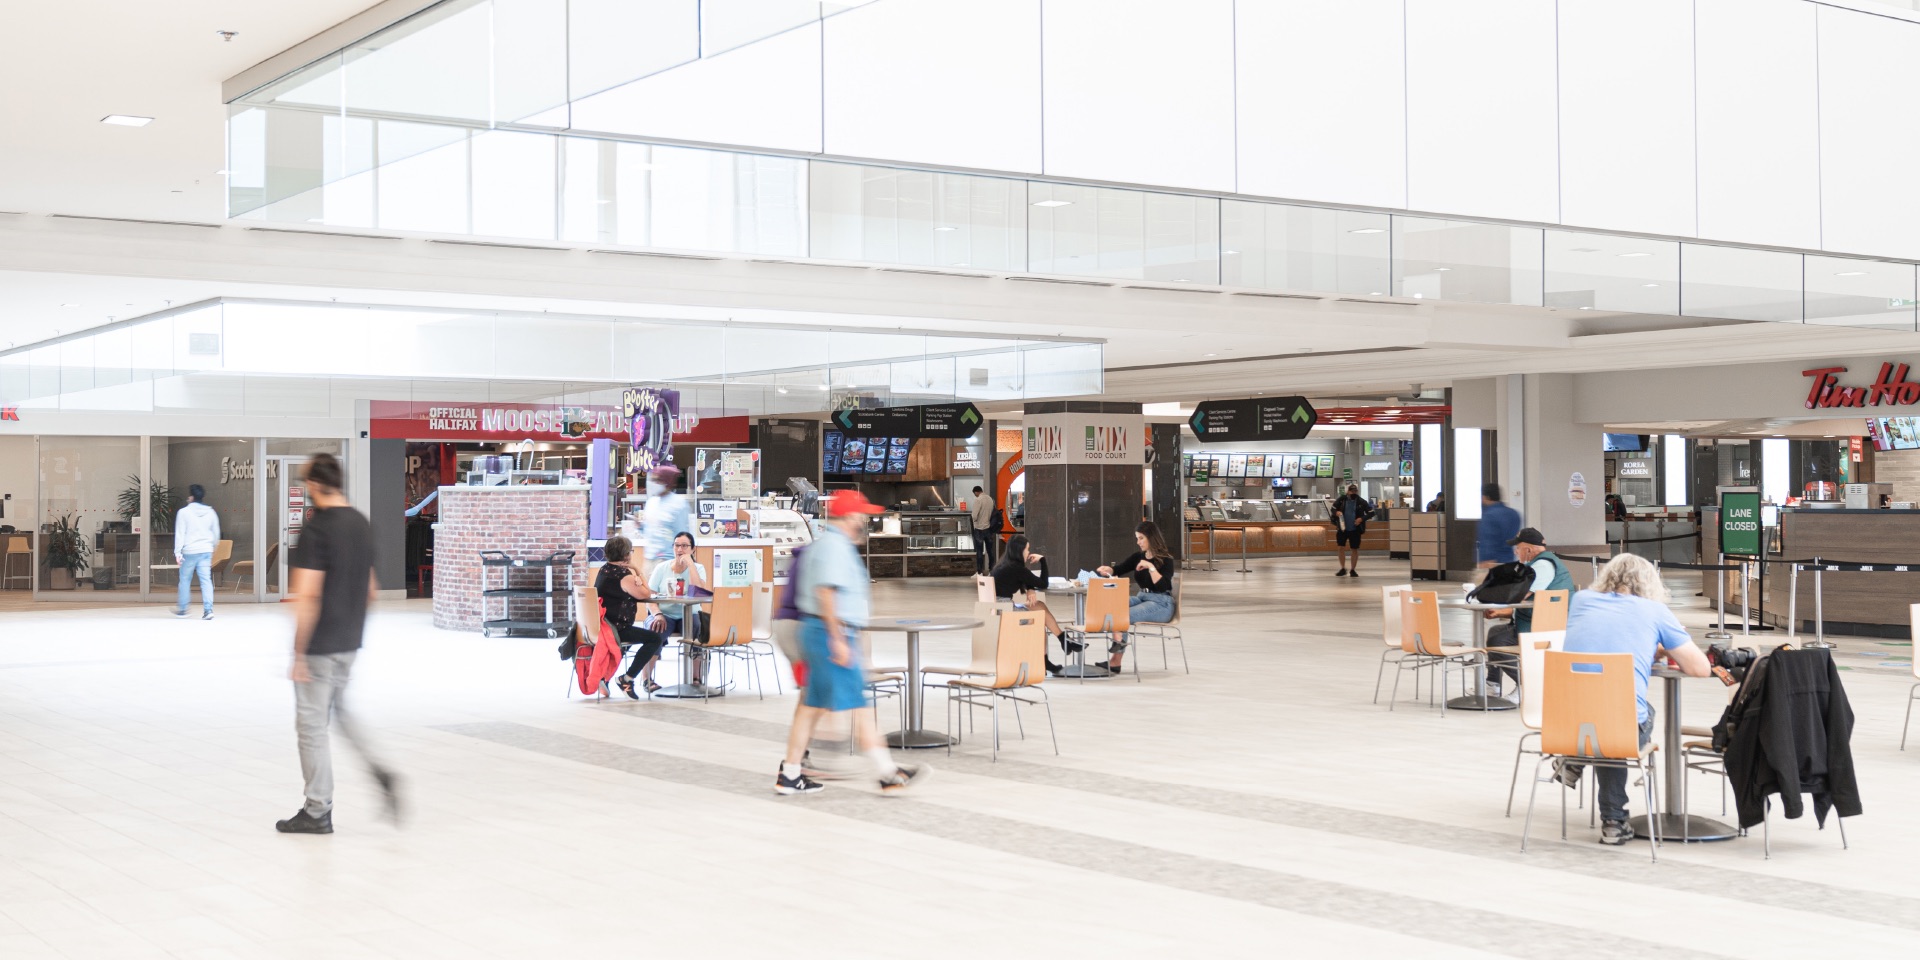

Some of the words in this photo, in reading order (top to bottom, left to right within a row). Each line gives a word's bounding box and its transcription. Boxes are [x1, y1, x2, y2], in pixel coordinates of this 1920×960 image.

[1802, 366, 1867, 409] Tim
[429, 407, 478, 419] OFFICIAL
[624, 389, 660, 418] Booster
[429, 419, 478, 431] HALIFAX
[1037, 425, 1061, 452] MIX
[1096, 426, 1127, 452] MIX
[230, 459, 278, 480] Scotiank
[626, 445, 654, 473] Juice
[953, 460, 980, 469] EXPRESS
[1730, 508, 1752, 518] LANE
[1724, 522, 1758, 530] CLOSED
